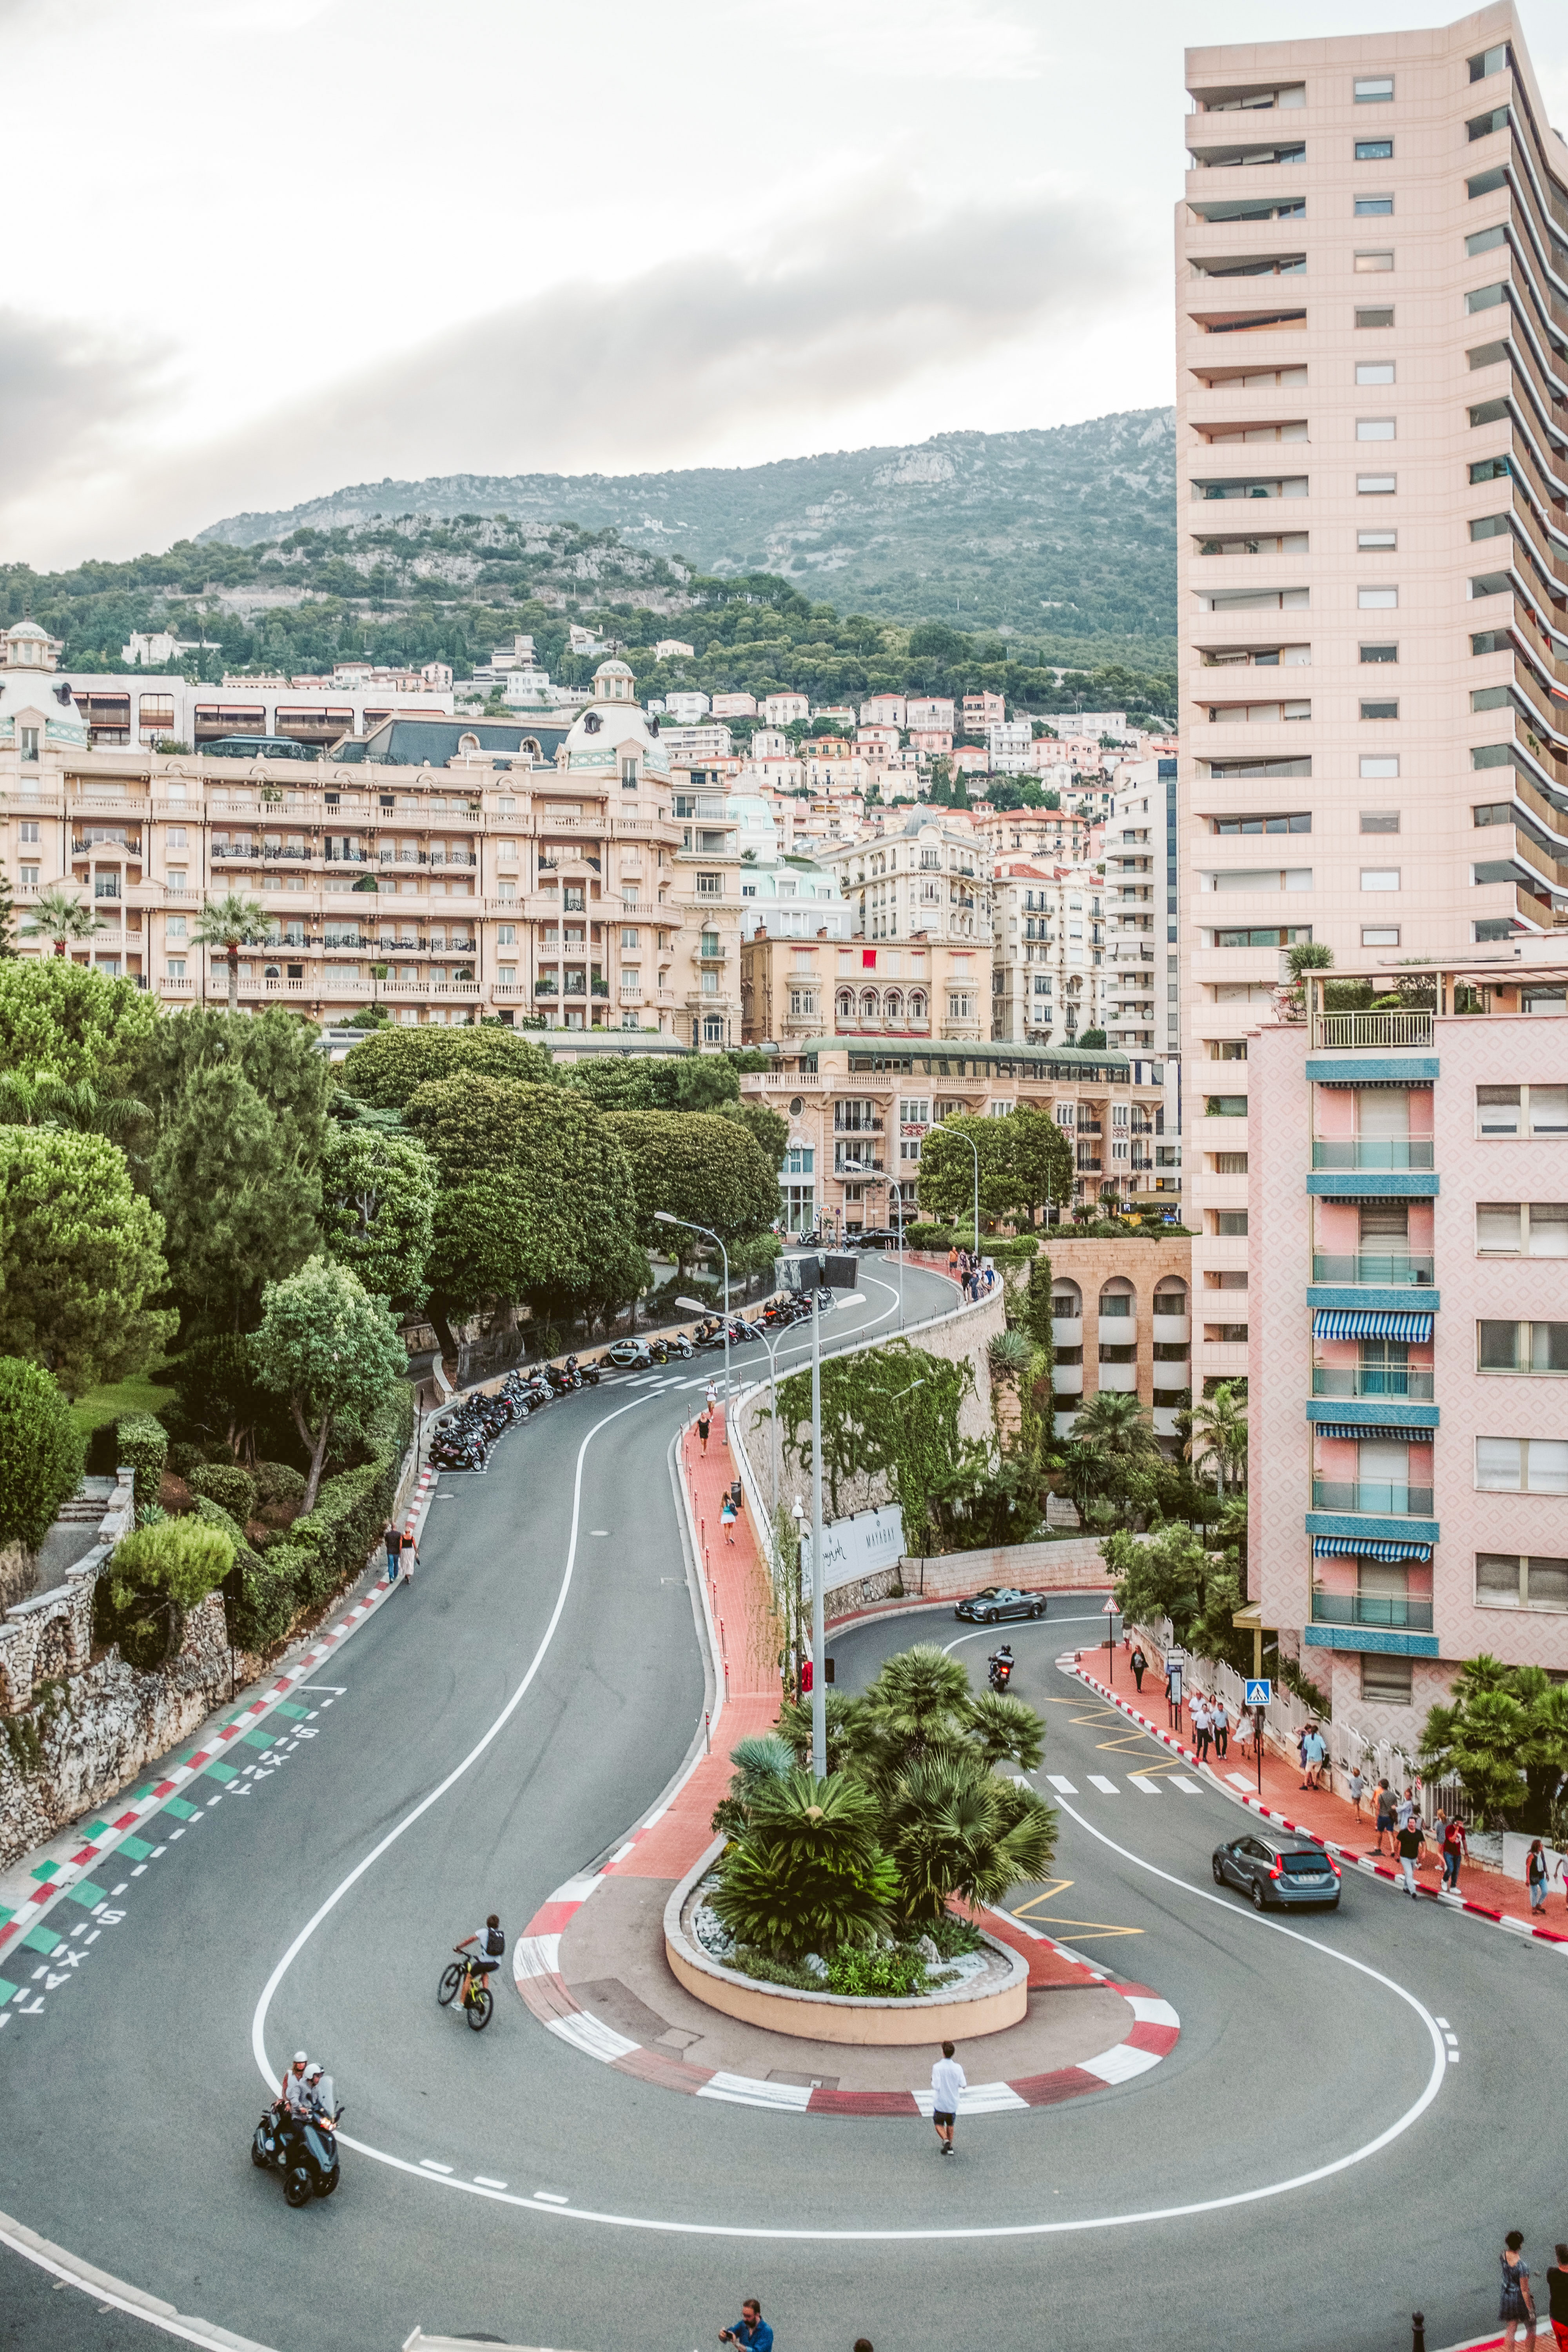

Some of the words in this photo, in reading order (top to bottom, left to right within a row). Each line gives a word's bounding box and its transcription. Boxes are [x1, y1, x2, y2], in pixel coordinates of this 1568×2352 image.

[866, 1526, 895, 1549] MAYABAY
[231, 1728, 320, 1795] TAXIS
[18, 1910, 127, 2014] TAXIS
